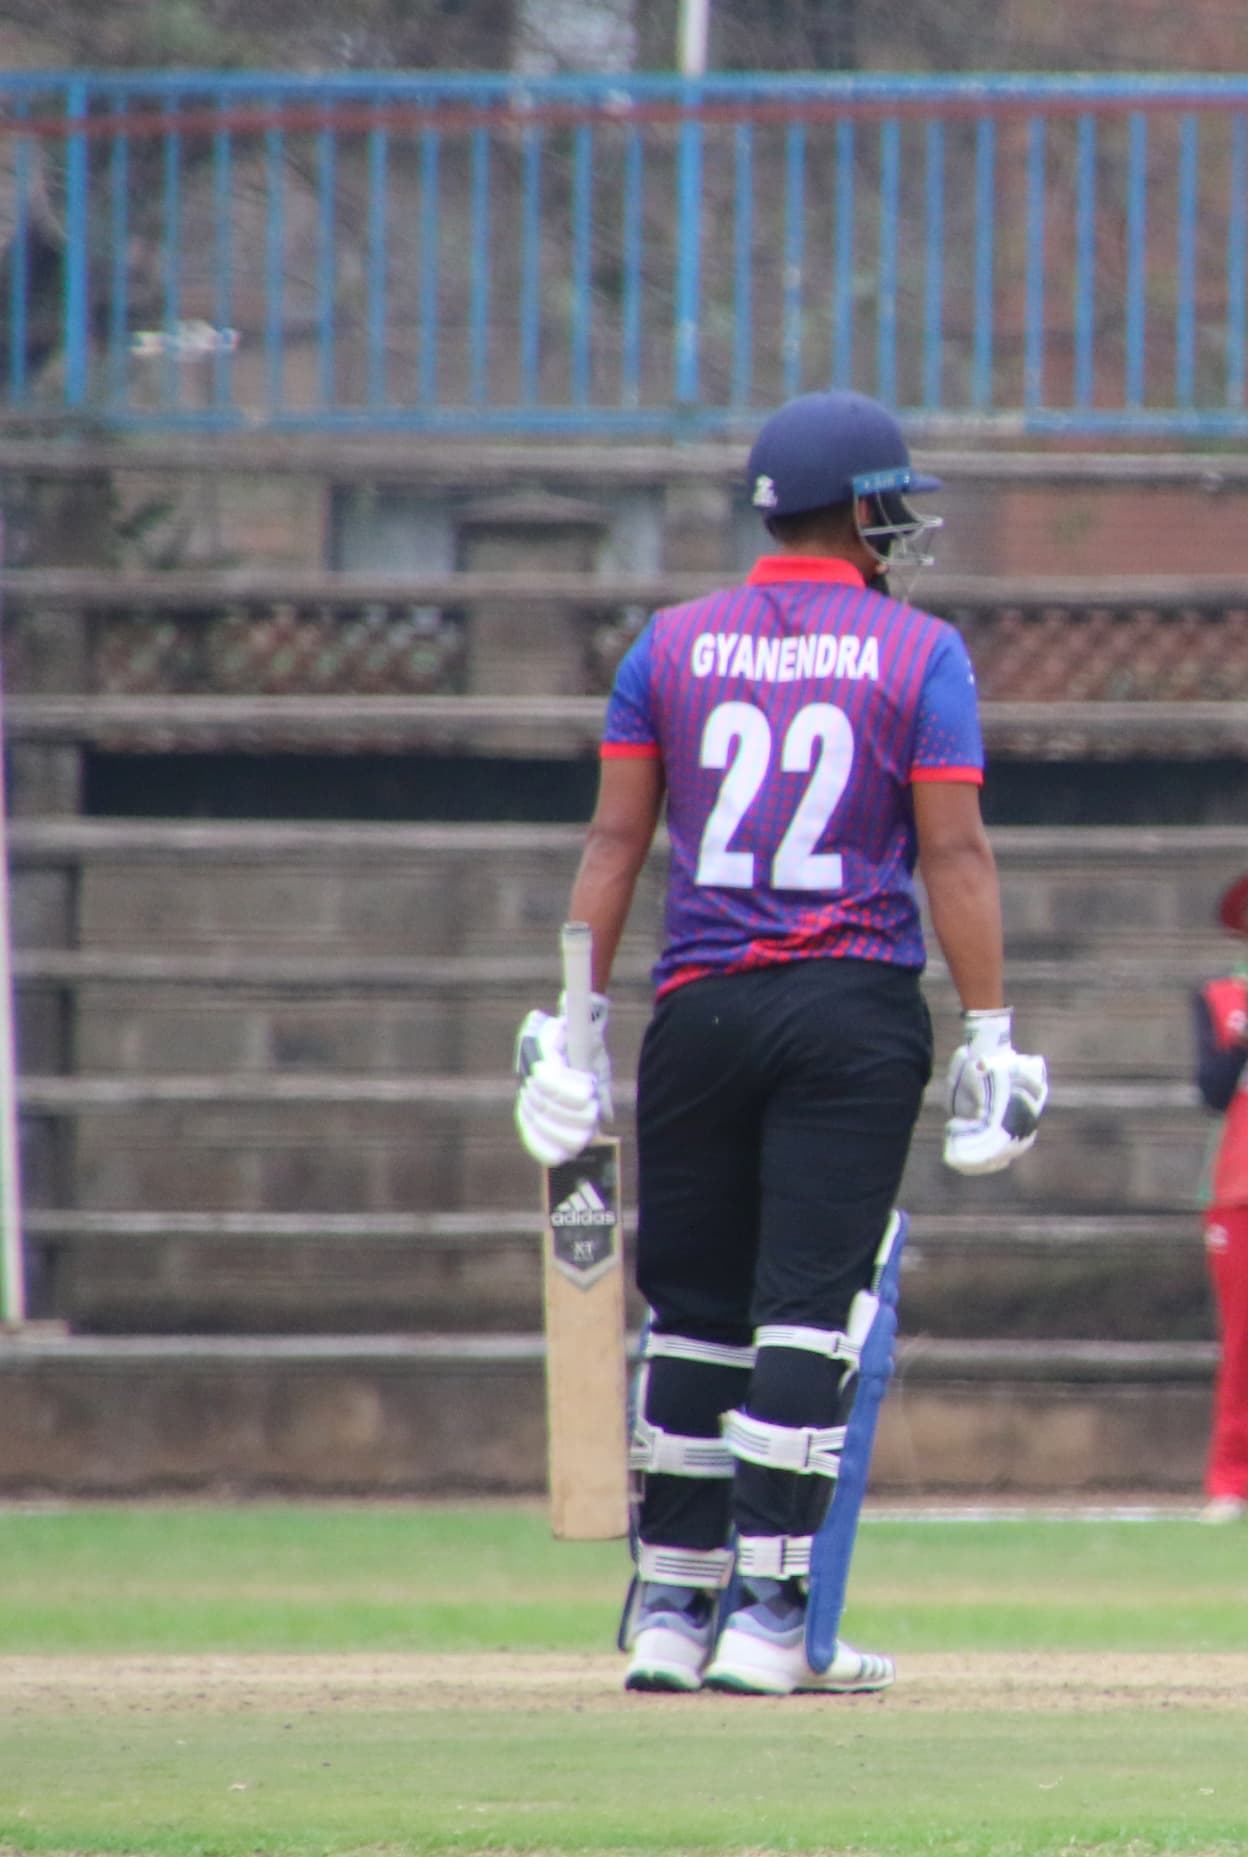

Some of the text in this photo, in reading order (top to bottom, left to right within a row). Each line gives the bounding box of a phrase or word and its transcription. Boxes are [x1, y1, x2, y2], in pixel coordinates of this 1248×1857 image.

[691, 631, 879, 682] GYANENDRA
[694, 700, 855, 890] 22
[552, 1208, 616, 1226] adidas
